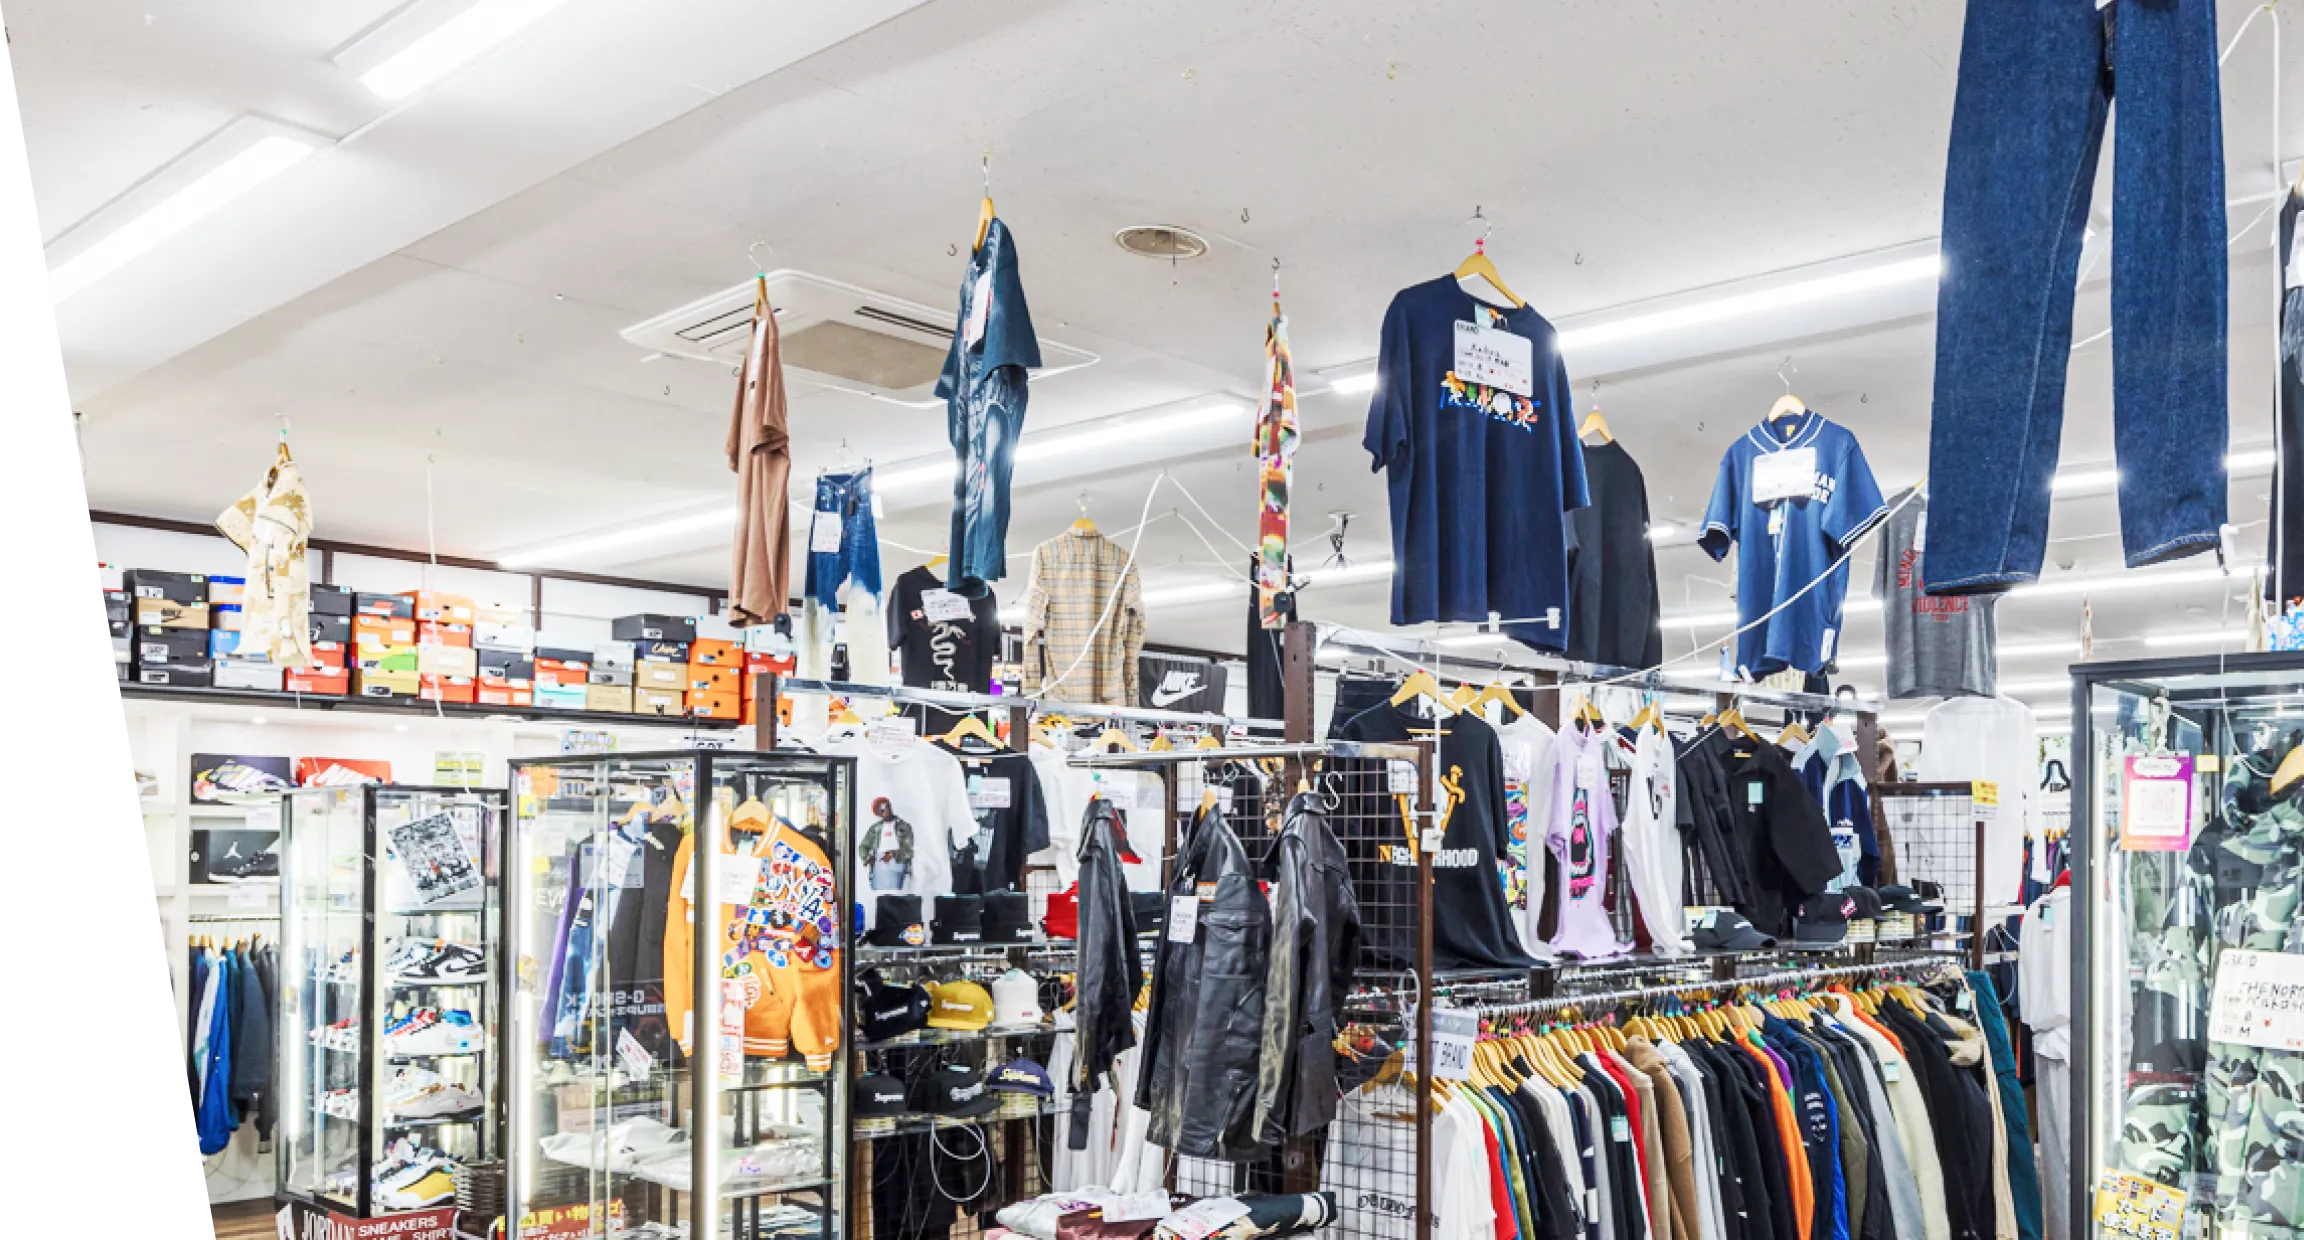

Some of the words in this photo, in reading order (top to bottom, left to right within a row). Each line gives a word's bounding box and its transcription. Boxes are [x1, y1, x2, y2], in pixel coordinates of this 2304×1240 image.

[1911, 595, 1968, 613] VIOLENCE
[1162, 671, 1200, 692] NIKE
[1378, 845, 1479, 867] NEIGHRHOOD
[1440, 1041, 1468, 1070] BRAND
[302, 1209, 355, 1240] JORDAN
[358, 1215, 438, 1237] SNEAKERS
